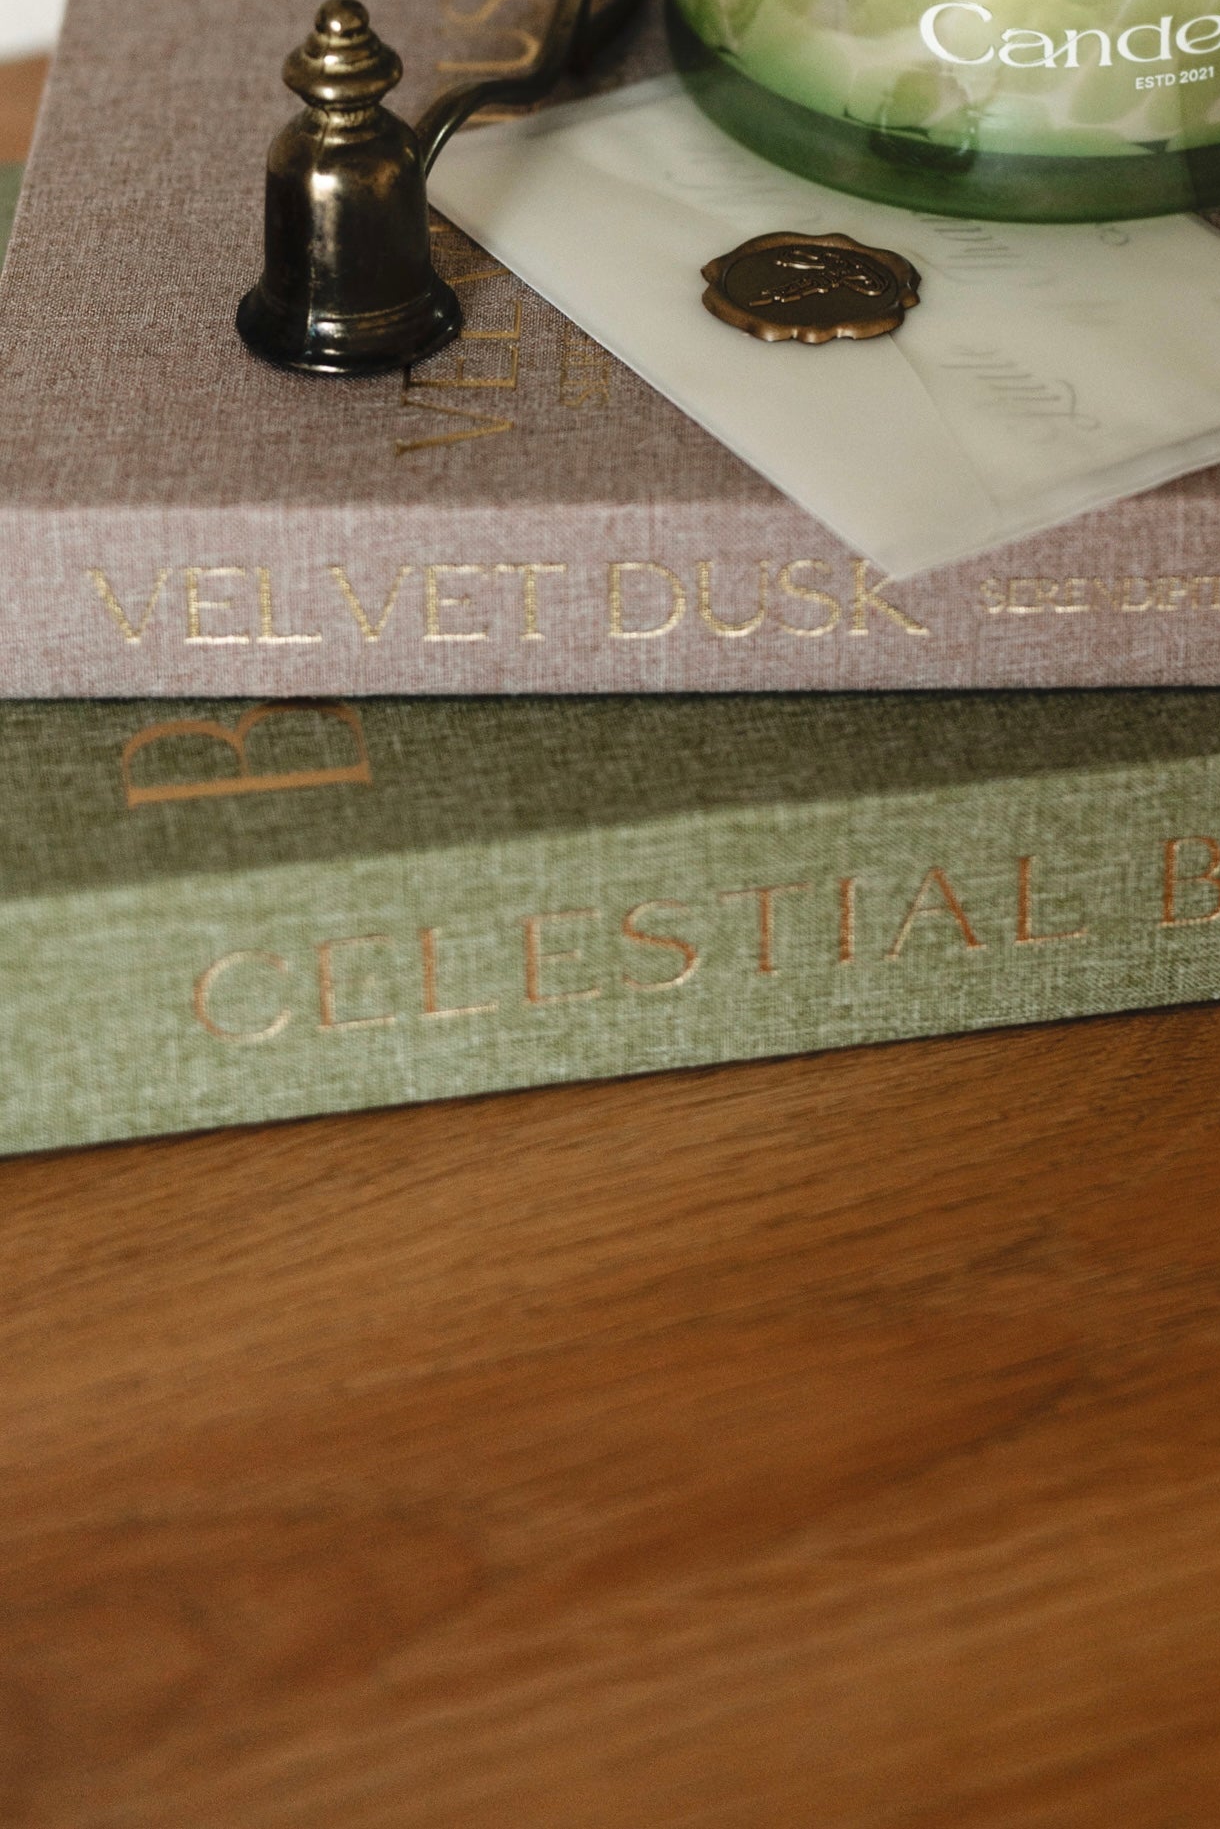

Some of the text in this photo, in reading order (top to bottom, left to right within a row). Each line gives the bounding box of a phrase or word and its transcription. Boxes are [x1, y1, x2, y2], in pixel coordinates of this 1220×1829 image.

[1135, 66, 1216, 90] ESTD 2021
[86, 558, 931, 645] VELVET DUSK
[193, 856, 1089, 1044] CELESTIAL
